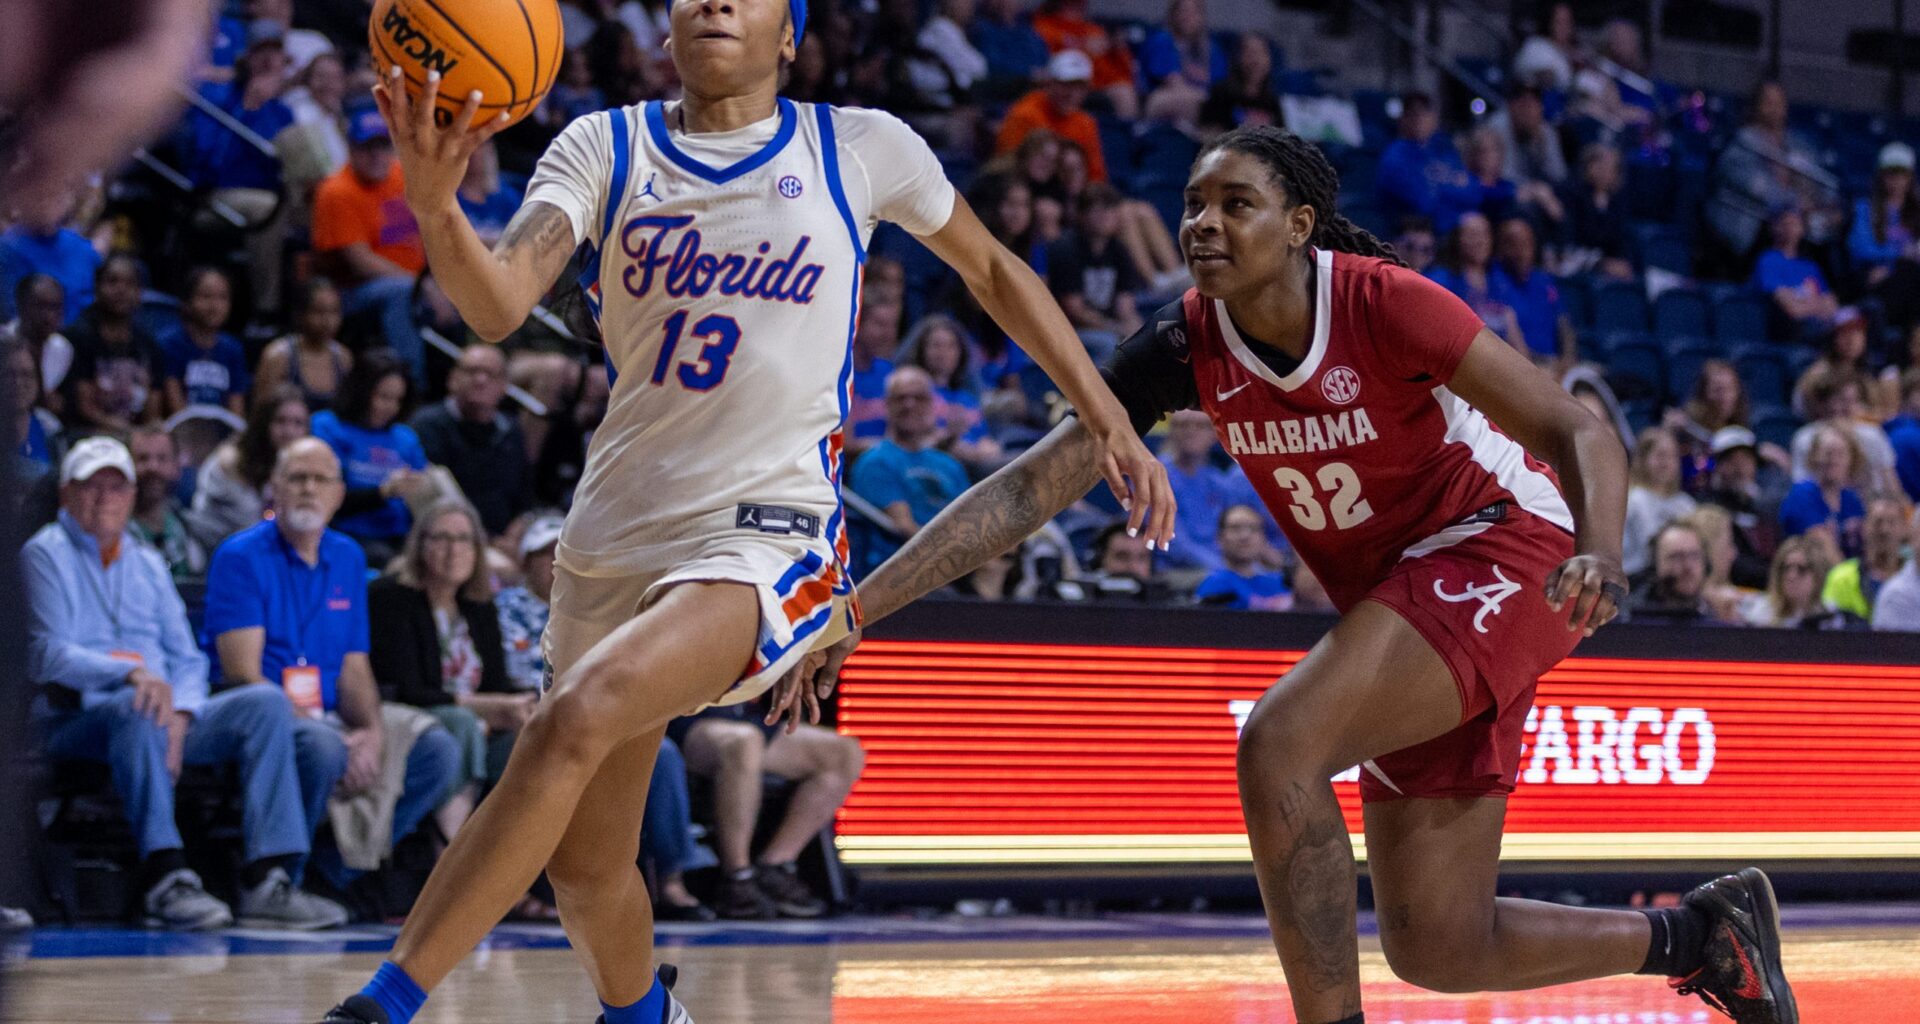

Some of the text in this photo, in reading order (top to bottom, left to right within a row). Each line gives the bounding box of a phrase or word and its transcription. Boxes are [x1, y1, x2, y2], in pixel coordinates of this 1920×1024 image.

[383, 3, 458, 80] NCAA
[779, 177, 802, 198] SEC
[621, 214, 825, 304] Florida
[651, 309, 742, 393] 13
[1323, 368, 1358, 402] SEC
[1227, 407, 1379, 455] ALABAMA
[796, 517, 809, 529] 46
[1273, 462, 1375, 531] 32
